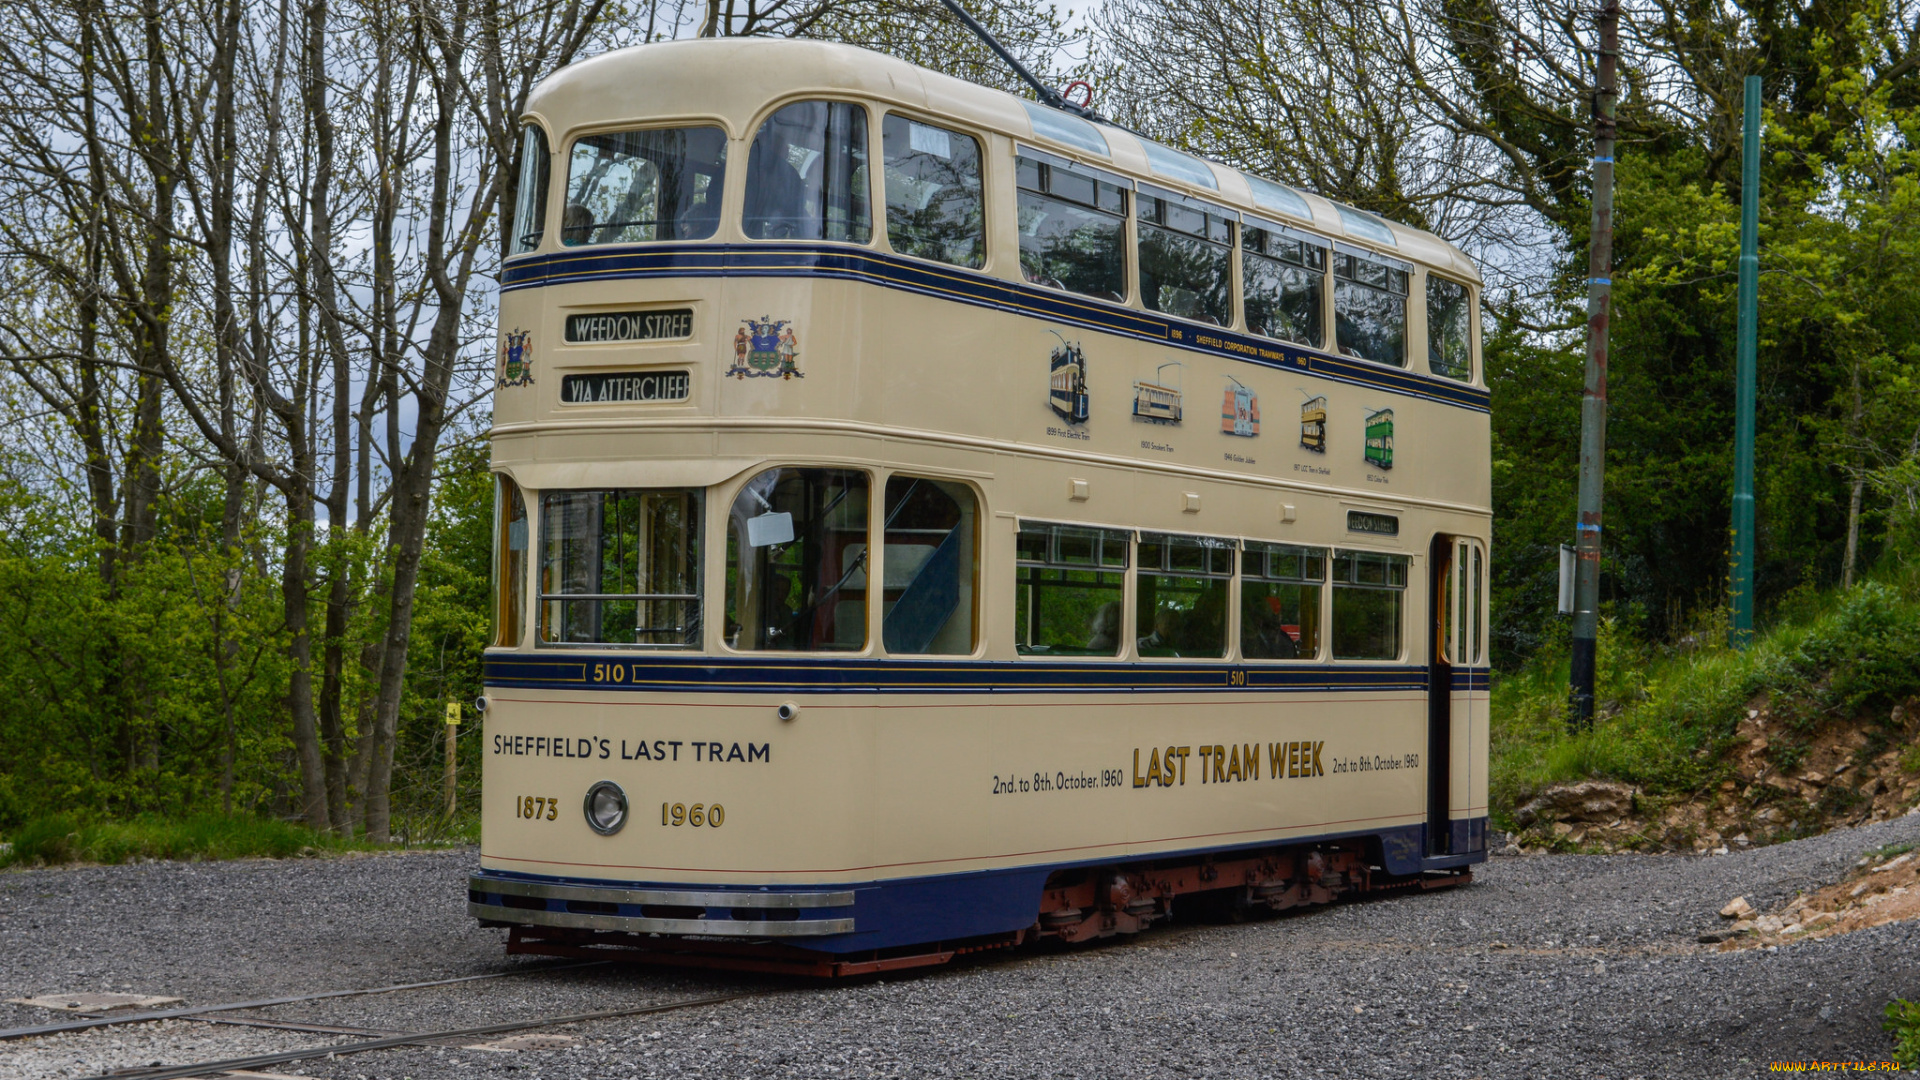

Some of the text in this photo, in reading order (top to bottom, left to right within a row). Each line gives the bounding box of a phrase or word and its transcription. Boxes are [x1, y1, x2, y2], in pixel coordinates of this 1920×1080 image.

[575, 315, 640, 342] WEEDON
[1171, 329, 1307, 366] 1896 SHEFFIELD CORPORATION TRAMWAYS 1960
[571, 379, 592, 403] VIA
[593, 663, 625, 683] 510
[1230, 670, 1245, 686] 510
[493, 734, 770, 763] SHEFFIELD'S LAST TRAM
[1132, 741, 1325, 789] LAST TRAM WEEK
[1350, 760, 1358, 772] to
[1403, 753, 1419, 768] 1960
[1019, 777, 1030, 793] to
[1101, 769, 1123, 788] 1960
[516, 795, 559, 821] 1873
[661, 802, 725, 828] 1960
